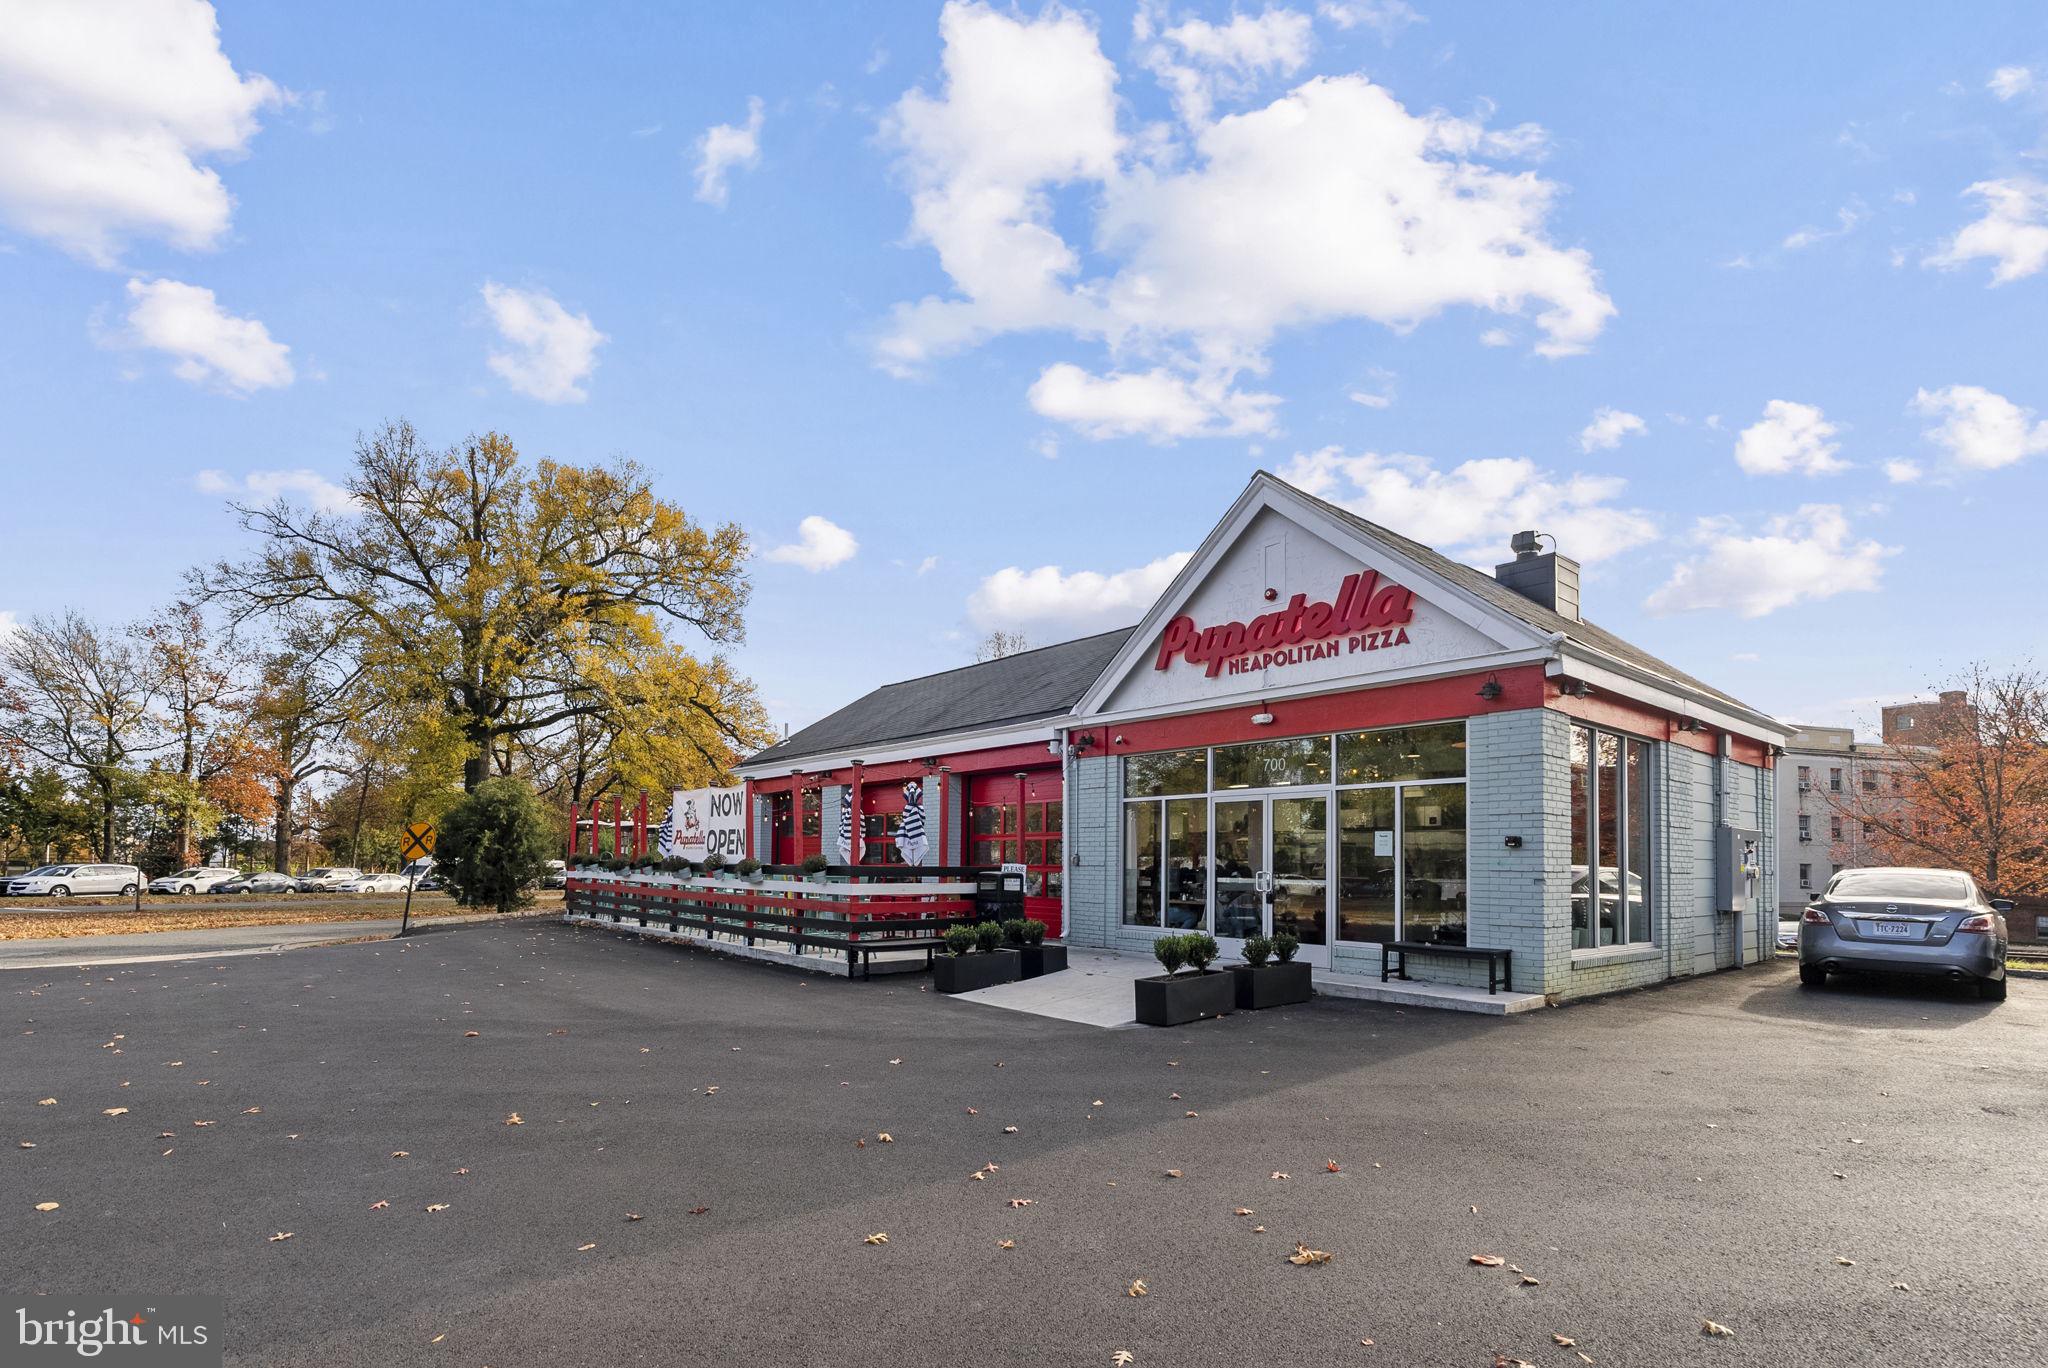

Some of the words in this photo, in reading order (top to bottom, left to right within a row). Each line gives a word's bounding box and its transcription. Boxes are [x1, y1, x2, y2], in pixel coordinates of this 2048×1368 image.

[1155, 569, 1415, 678] Pupatella
[1228, 639, 1340, 676] NEAPOLITAN
[1348, 627, 1411, 655] PIZZA
[1263, 757, 1286, 772] 700
[710, 791, 744, 817] NOW
[403, 837, 410, 846] R
[425, 835, 433, 845] R
[706, 828, 746, 855] OPEN
[1003, 865, 1026, 873] PLEASE
